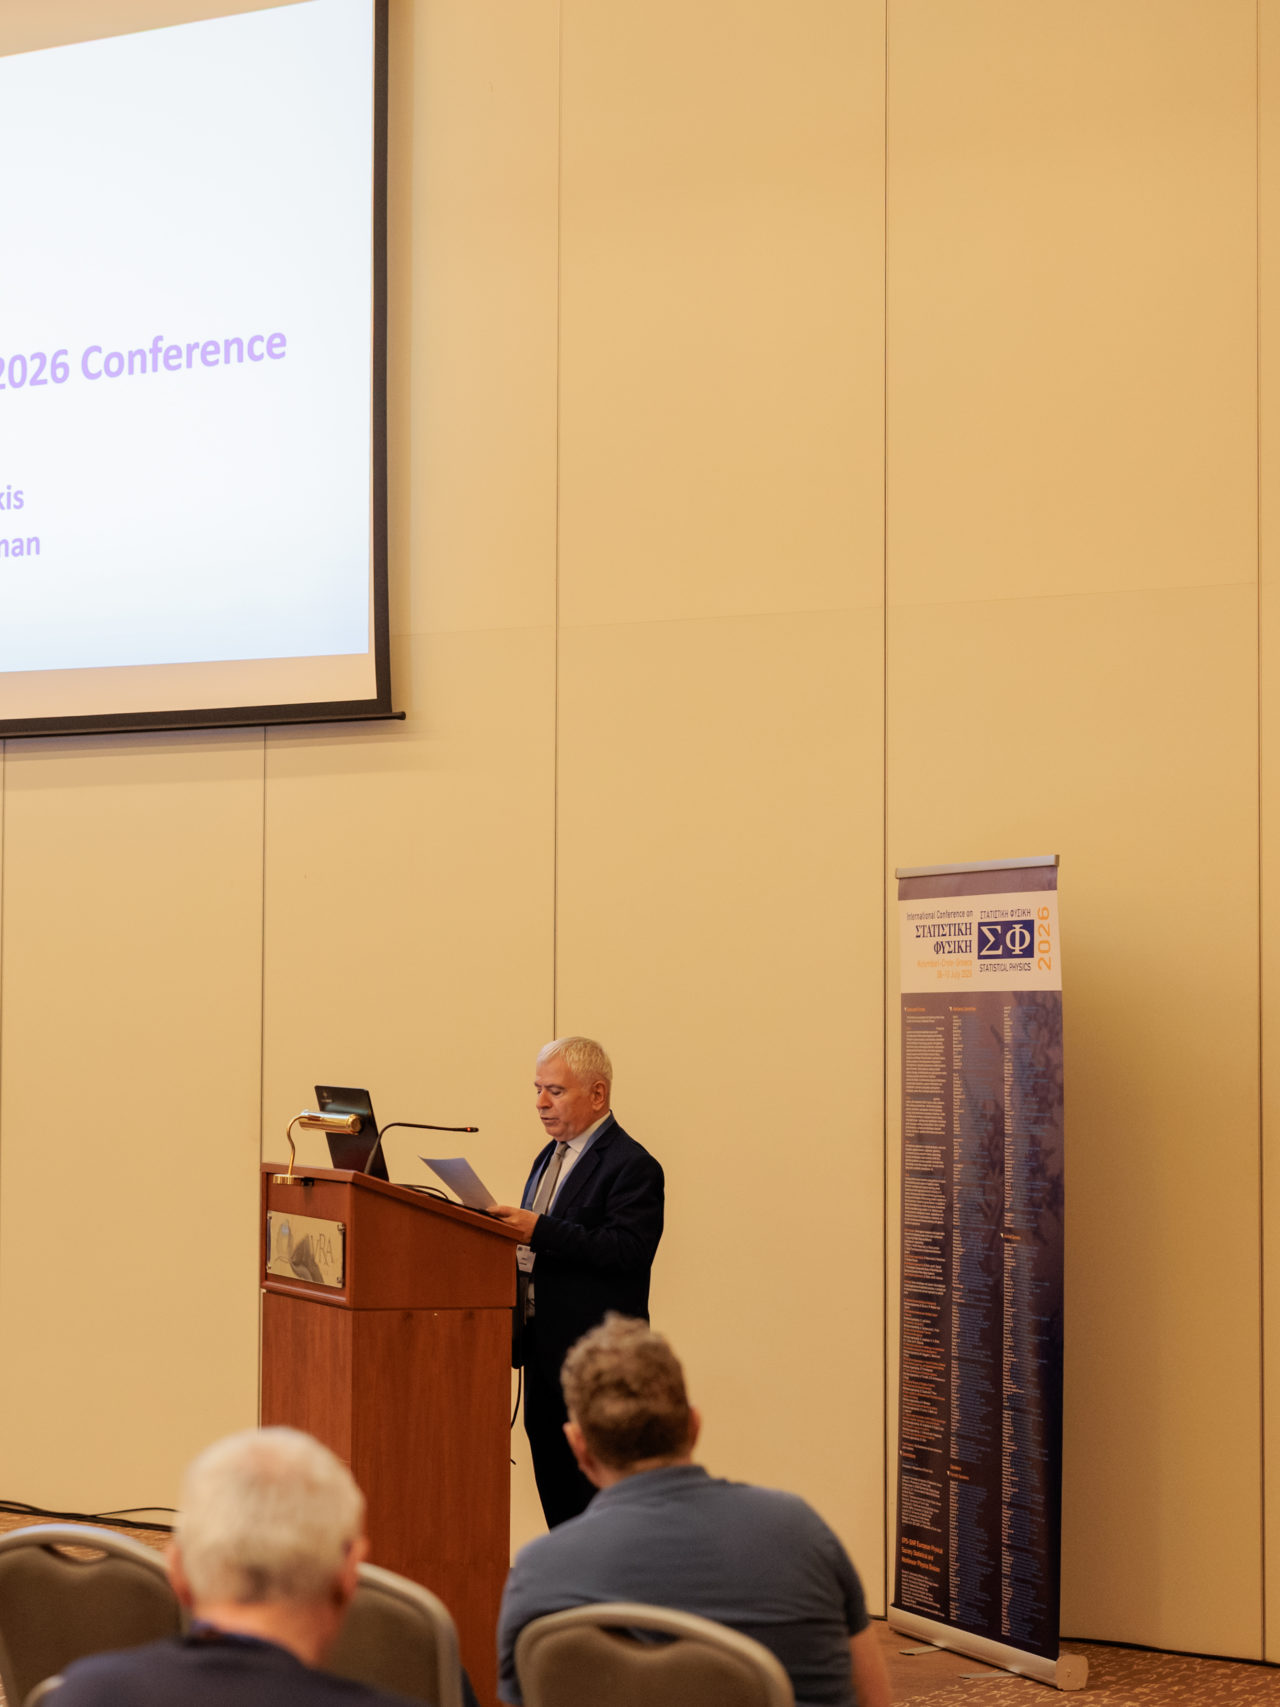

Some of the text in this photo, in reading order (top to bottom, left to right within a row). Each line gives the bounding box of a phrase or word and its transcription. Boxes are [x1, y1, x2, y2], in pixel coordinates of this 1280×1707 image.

[81, 332, 287, 380] Conference
[915, 922, 972, 938] ΣΤΑΤΙΣΤΙΚΗ
[1037, 906, 1052, 971] 2026
[933, 940, 972, 955] ΦΥΣΙΚΗ
